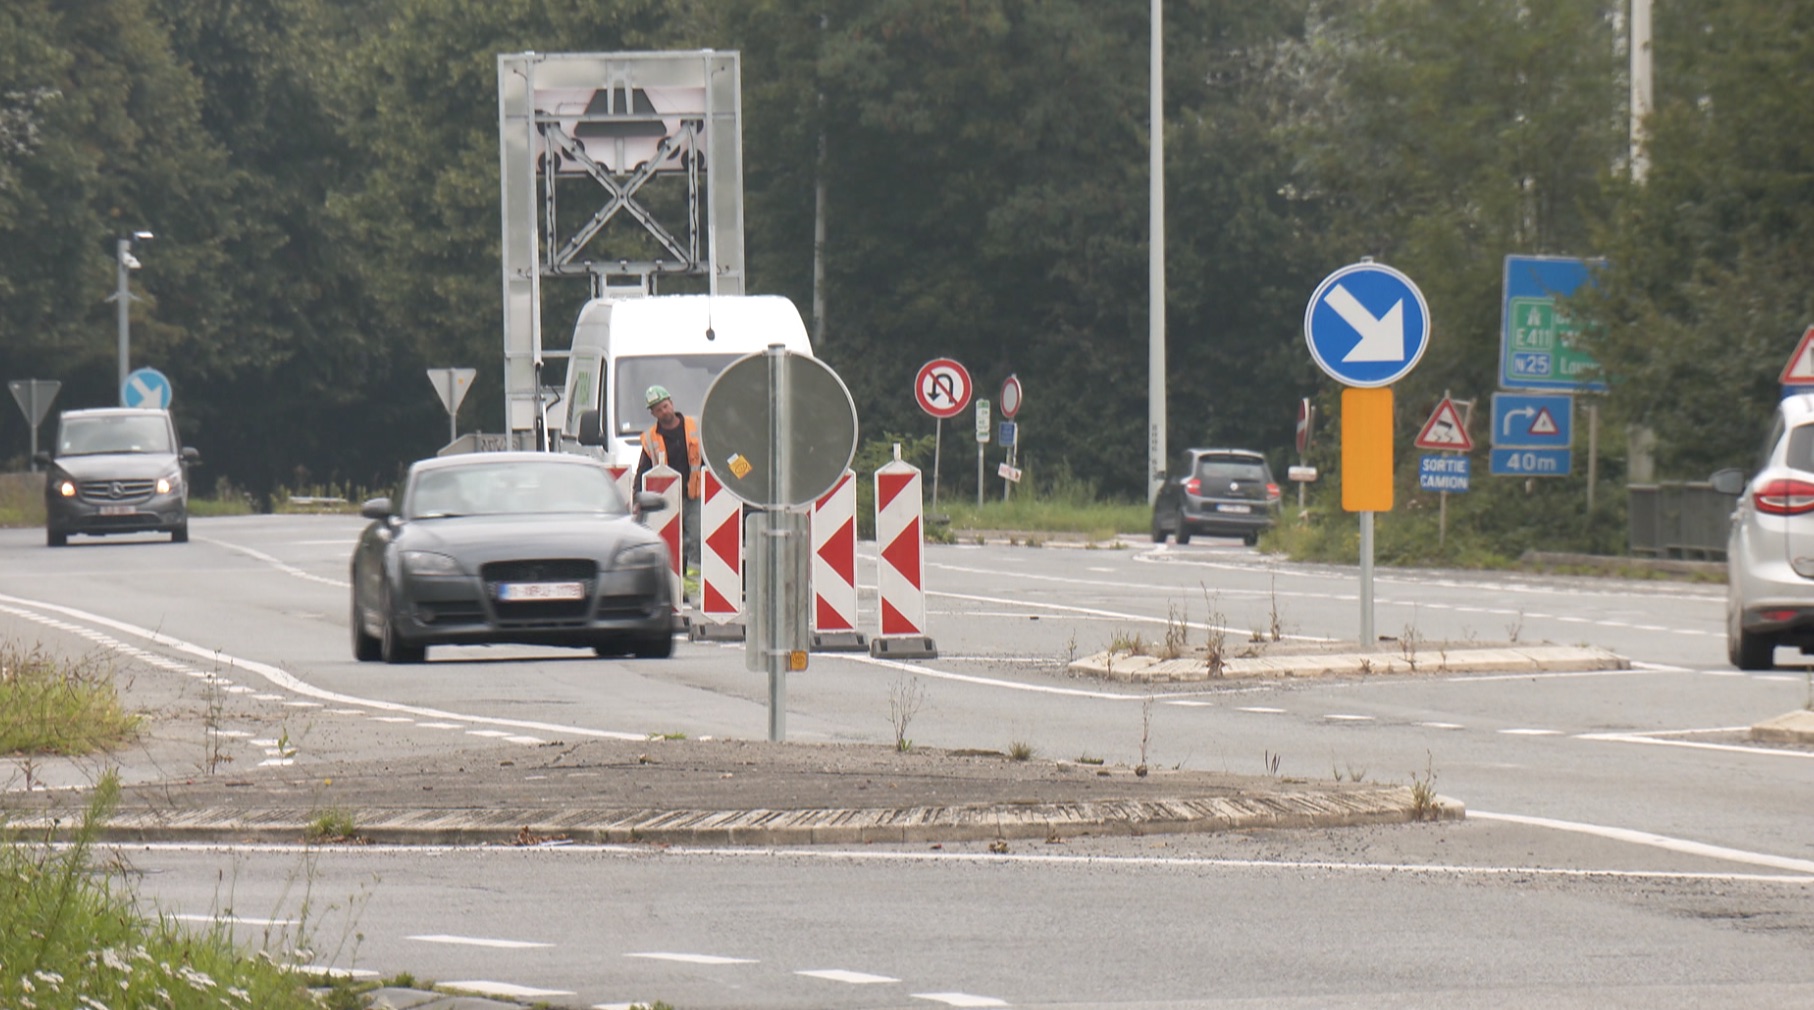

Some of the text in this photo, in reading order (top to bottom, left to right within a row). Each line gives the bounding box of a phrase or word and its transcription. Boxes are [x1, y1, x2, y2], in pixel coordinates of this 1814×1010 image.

[1514, 355, 1548, 374] N25
[1422, 458, 1466, 473] SORTIE
[1420, 475, 1469, 489] CAMION
